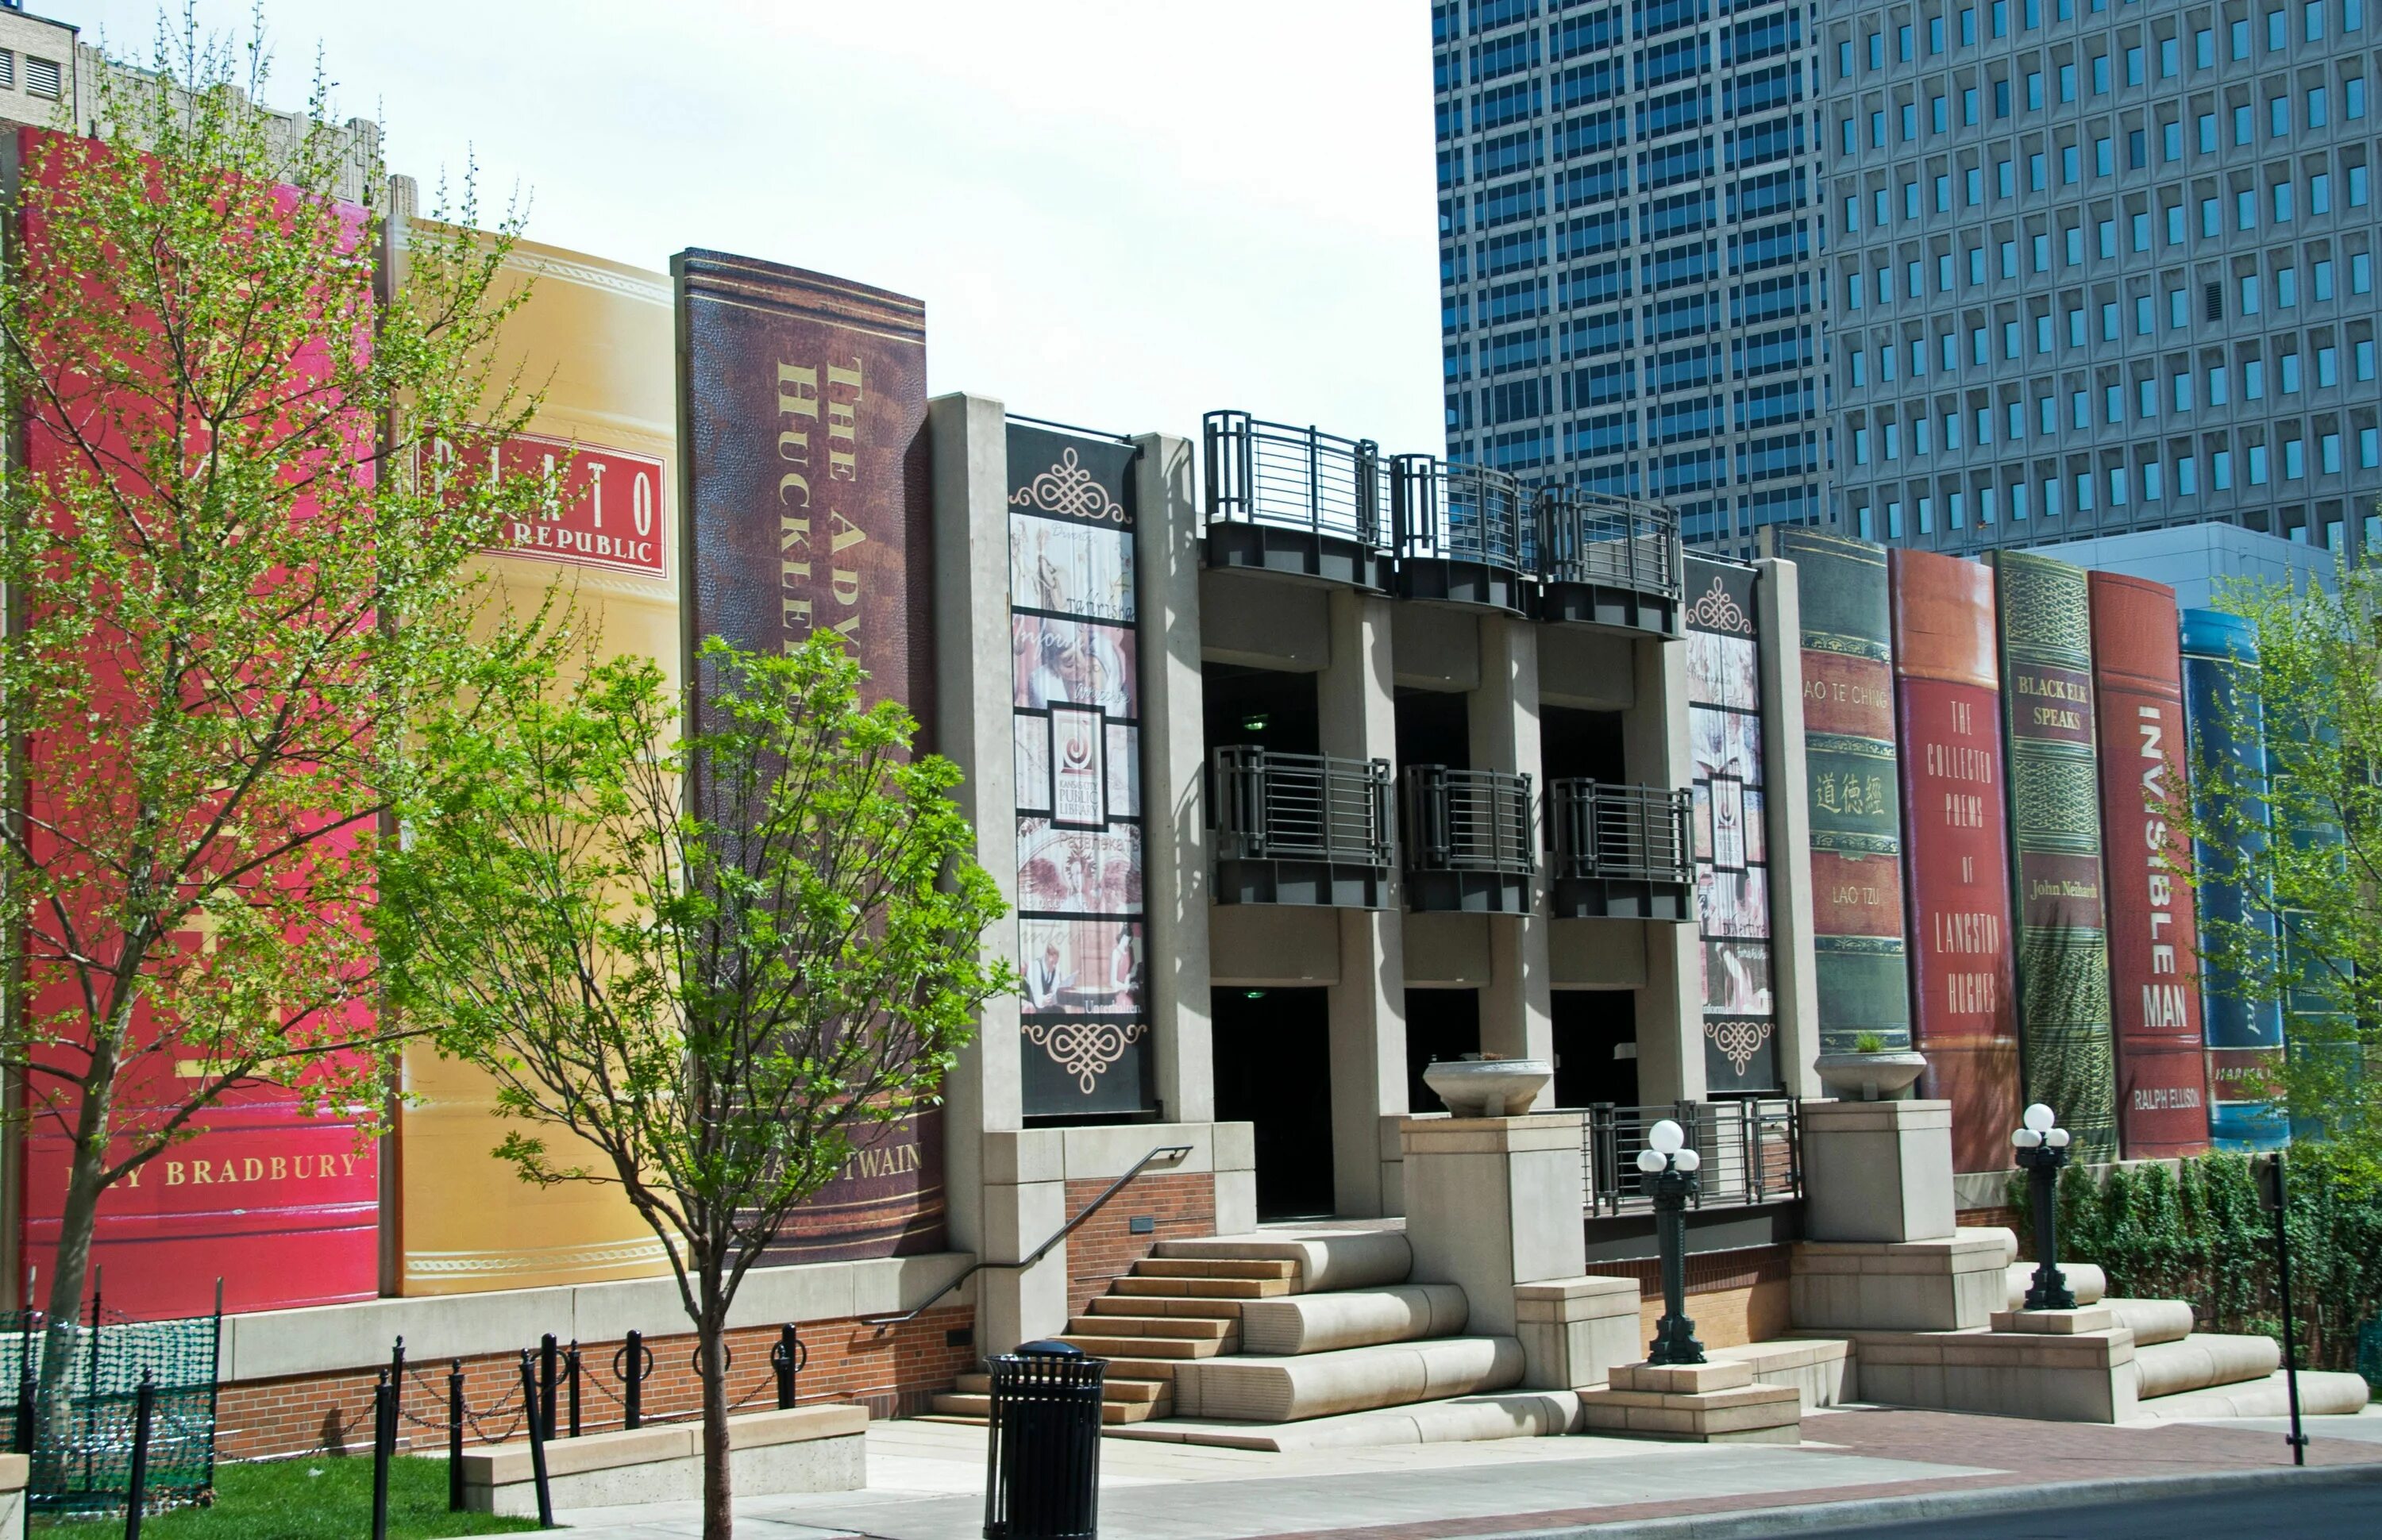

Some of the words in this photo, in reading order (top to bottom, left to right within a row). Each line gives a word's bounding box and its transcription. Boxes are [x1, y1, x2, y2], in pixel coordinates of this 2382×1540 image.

[827, 356, 863, 482] THE
[514, 522, 653, 562] REPUBLIC
[1803, 680, 1827, 699] AO
[1832, 683, 1846, 702] TE
[1852, 686, 1887, 709] CHING
[2018, 676, 2066, 699] BLACK
[2066, 682, 2088, 704] ELK
[1950, 700, 1972, 736] THE
[2033, 706, 2080, 730] SPEAKS
[1927, 743, 1992, 784] COLLECTED
[1059, 789, 1099, 805] PUBLIC
[1060, 803, 1098, 817] LIBRARY
[1945, 793, 1983, 828] POEMS
[2139, 705, 2176, 975] INVISIBLE
[1962, 856, 1974, 884] OF
[1833, 886, 1859, 903] LAO
[1862, 887, 1880, 905] TZU
[2030, 879, 2060, 901] John
[1935, 911, 2000, 953] LANGSTON
[1948, 972, 1995, 1014] HUGHES
[2142, 984, 2187, 1027] MAN
[2133, 1088, 2168, 1111] RALPH
[2168, 1087, 2201, 1109] ELLISON
[65, 1162, 147, 1191] AY
[165, 1153, 368, 1186] BRADBURY
[843, 1142, 923, 1180] TWAIN
